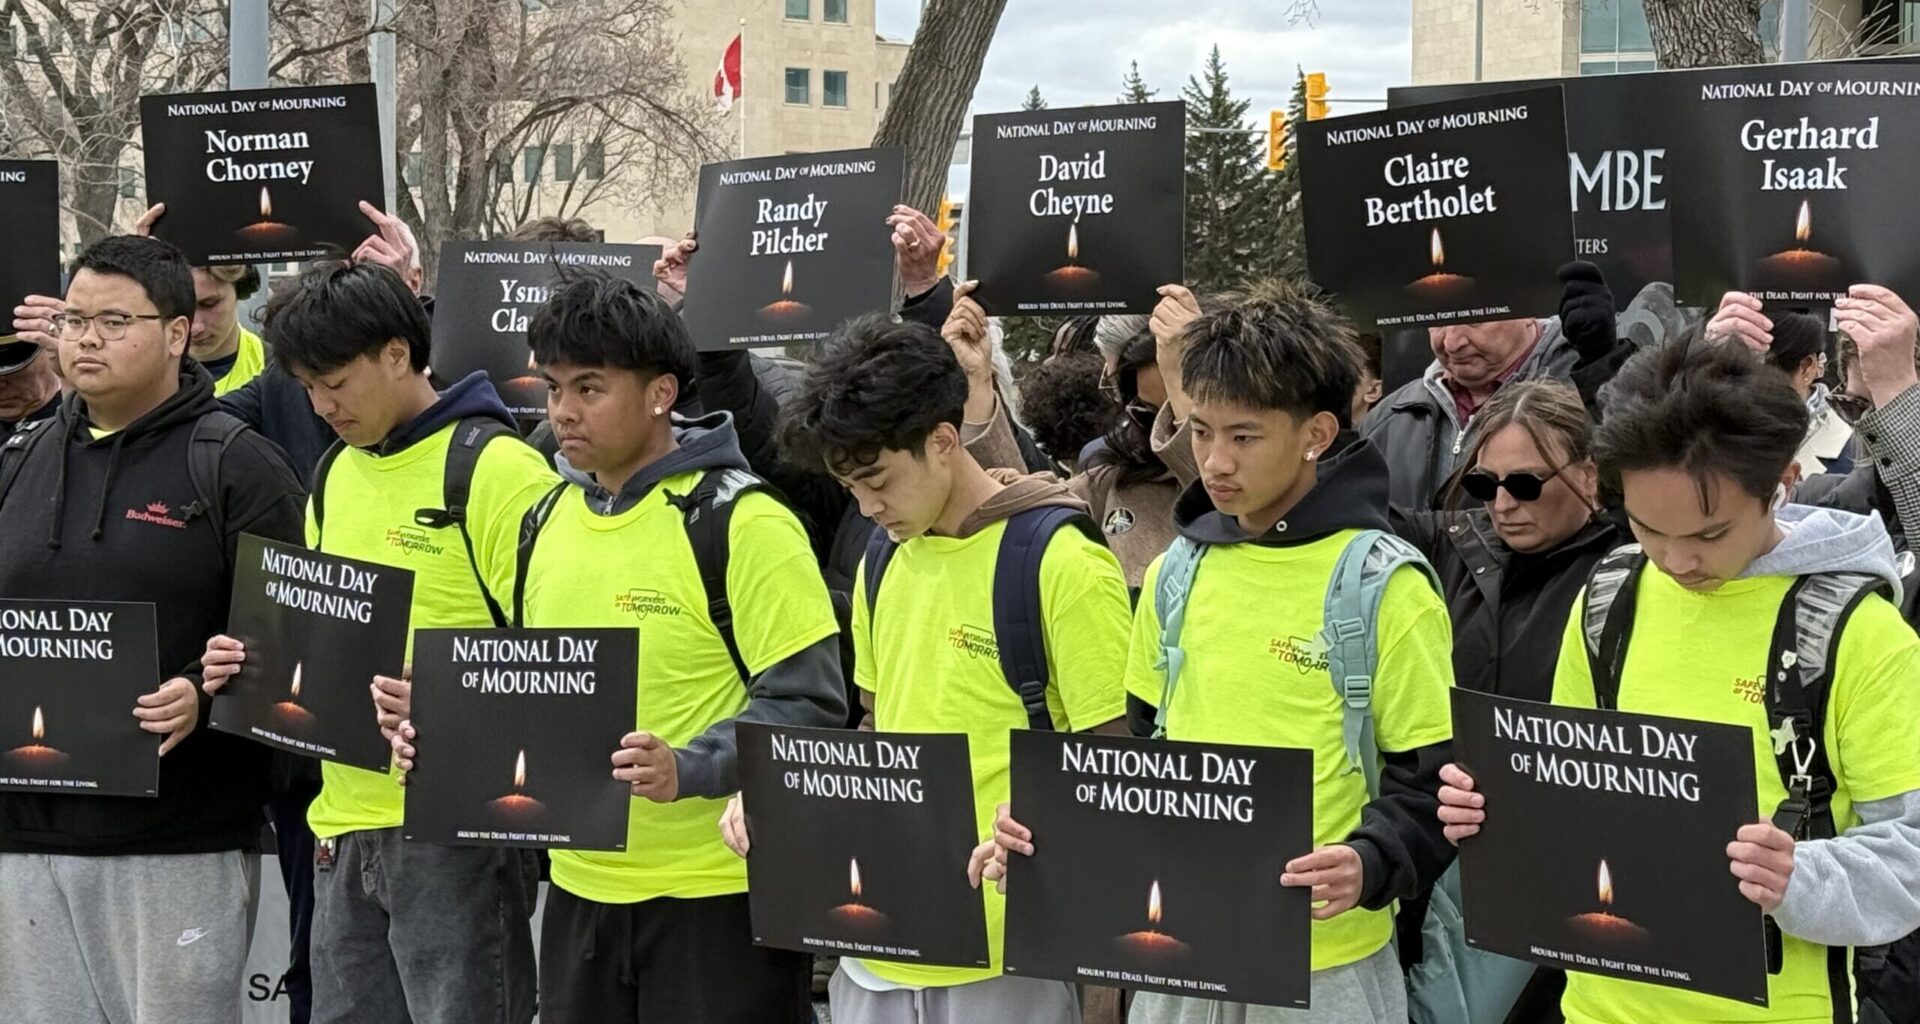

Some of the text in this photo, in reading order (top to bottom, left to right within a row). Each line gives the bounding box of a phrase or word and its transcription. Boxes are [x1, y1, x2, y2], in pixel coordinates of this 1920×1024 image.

[168, 96, 346, 117] NATIONAL DAY OF MOURNING
[1702, 83, 1774, 100] NATIONAL
[1780, 80, 1814, 96] DAY
[1817, 82, 1833, 92] OF
[204, 130, 310, 154] Norman
[997, 116, 1156, 138] NATIONAL DAY OF MOURNING
[1326, 106, 1528, 146] NATIONAL DAY OF MOURNING
[1740, 116, 1879, 150] Gerhard
[206, 157, 314, 185] Chorney
[720, 160, 876, 186] NATIONAL DAY OF MOURNING
[1038, 150, 1106, 182] David
[1384, 152, 1470, 186] Claire
[1761, 156, 1848, 190] Isaak
[756, 193, 828, 228] Randy
[1029, 188, 1114, 223] Cheyne
[1364, 184, 1498, 227] Bertholet
[750, 226, 828, 256] Pilcher
[464, 252, 520, 264] NATIONAL
[524, 252, 547, 264] DAY
[261, 546, 378, 594] NATIONAL DAY
[266, 580, 372, 624] OF MOURNING
[622, 603, 682, 615] TOMORROW
[68, 608, 114, 632] DAY
[452, 636, 599, 662] NATIONAL DAY
[462, 666, 596, 694] OF MOURNING
[1494, 706, 1698, 762] NATIONAL DAY
[771, 733, 920, 769] NATIONAL DAY
[1061, 742, 1257, 786] NATIONAL DAY
[784, 768, 924, 803] OF MOURNING
[1510, 751, 1700, 802] OF MOURNING
[1076, 781, 1254, 823] OF MOURNING
[1531, 945, 1558, 958] MOURN
[1560, 952, 1574, 962] THE
[1601, 958, 1625, 970] FIGHT
[1626, 963, 1642, 972] FOR
[1644, 965, 1659, 975] THE
[1077, 966, 1104, 977] MOURN
[1106, 970, 1119, 980] THE
[1144, 975, 1166, 985] FIGHT
[1168, 978, 1182, 987] FOR
[1183, 980, 1198, 989] THE
